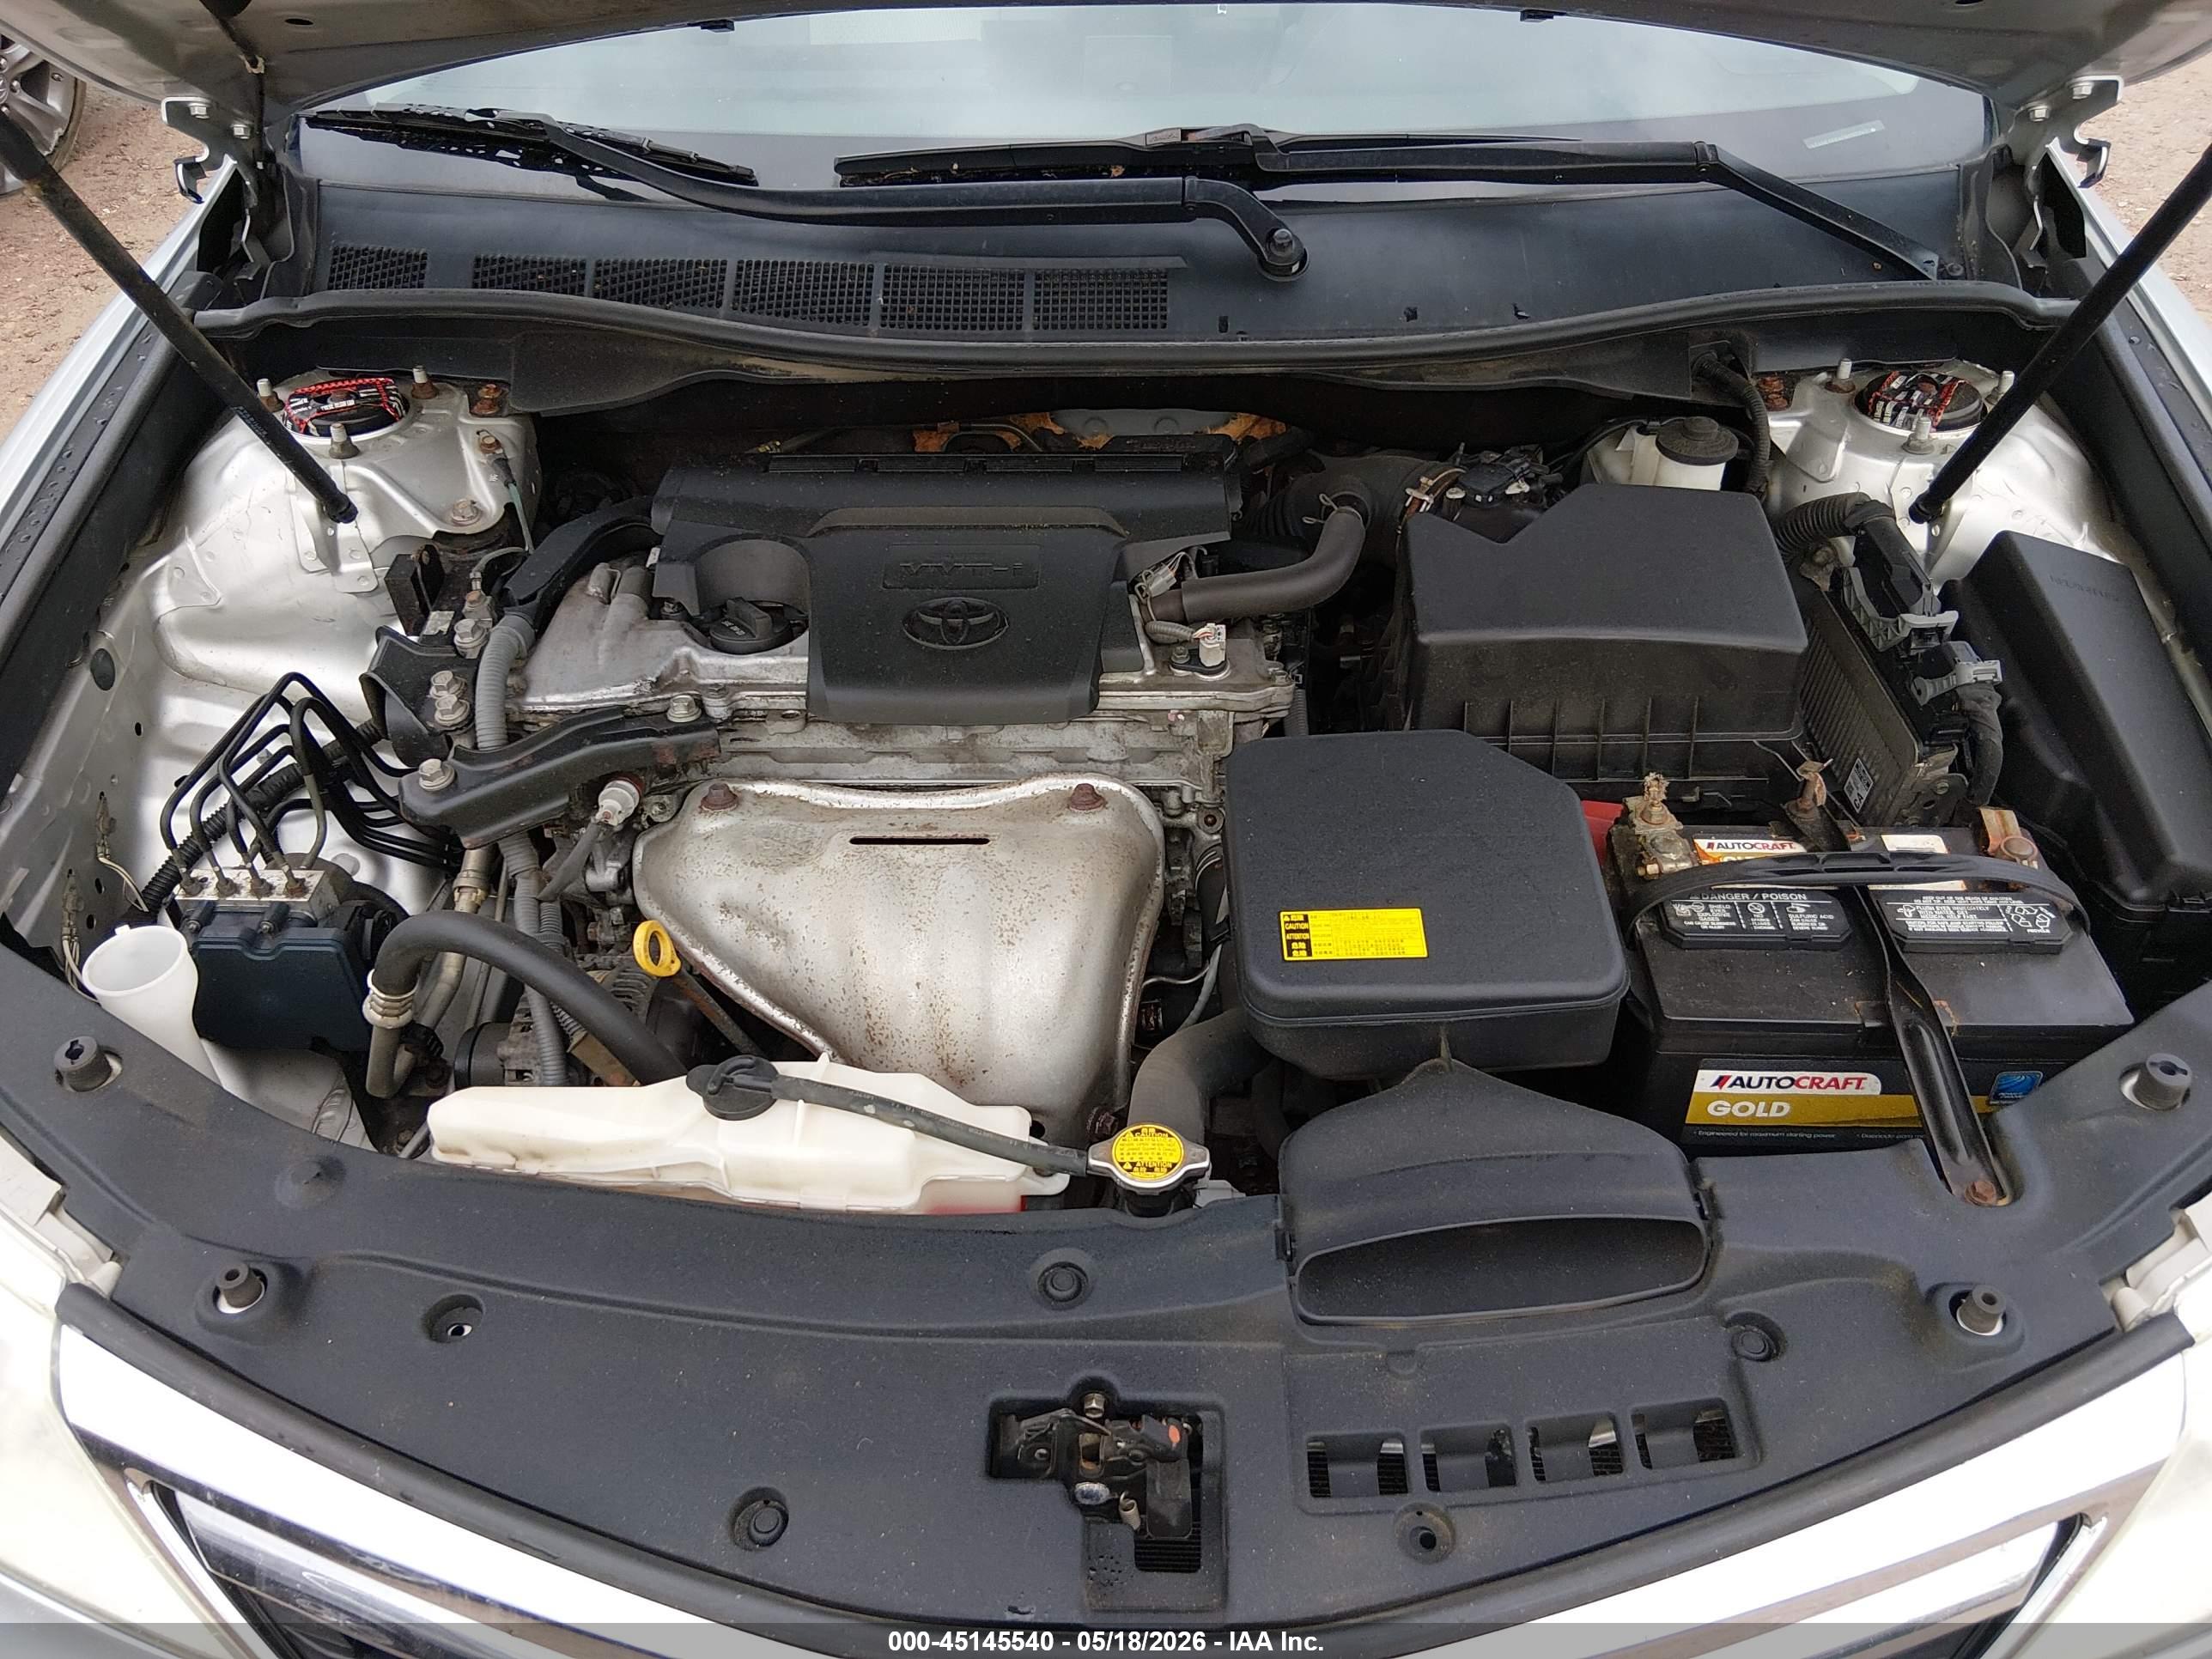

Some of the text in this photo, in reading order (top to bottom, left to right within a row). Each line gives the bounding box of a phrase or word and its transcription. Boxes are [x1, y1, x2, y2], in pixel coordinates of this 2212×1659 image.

[1717, 842, 1794, 850] AUTOCRAFT
[1727, 1075, 1868, 1091] AUTOCRAFT
[1706, 1100, 1791, 1117] GOLD
